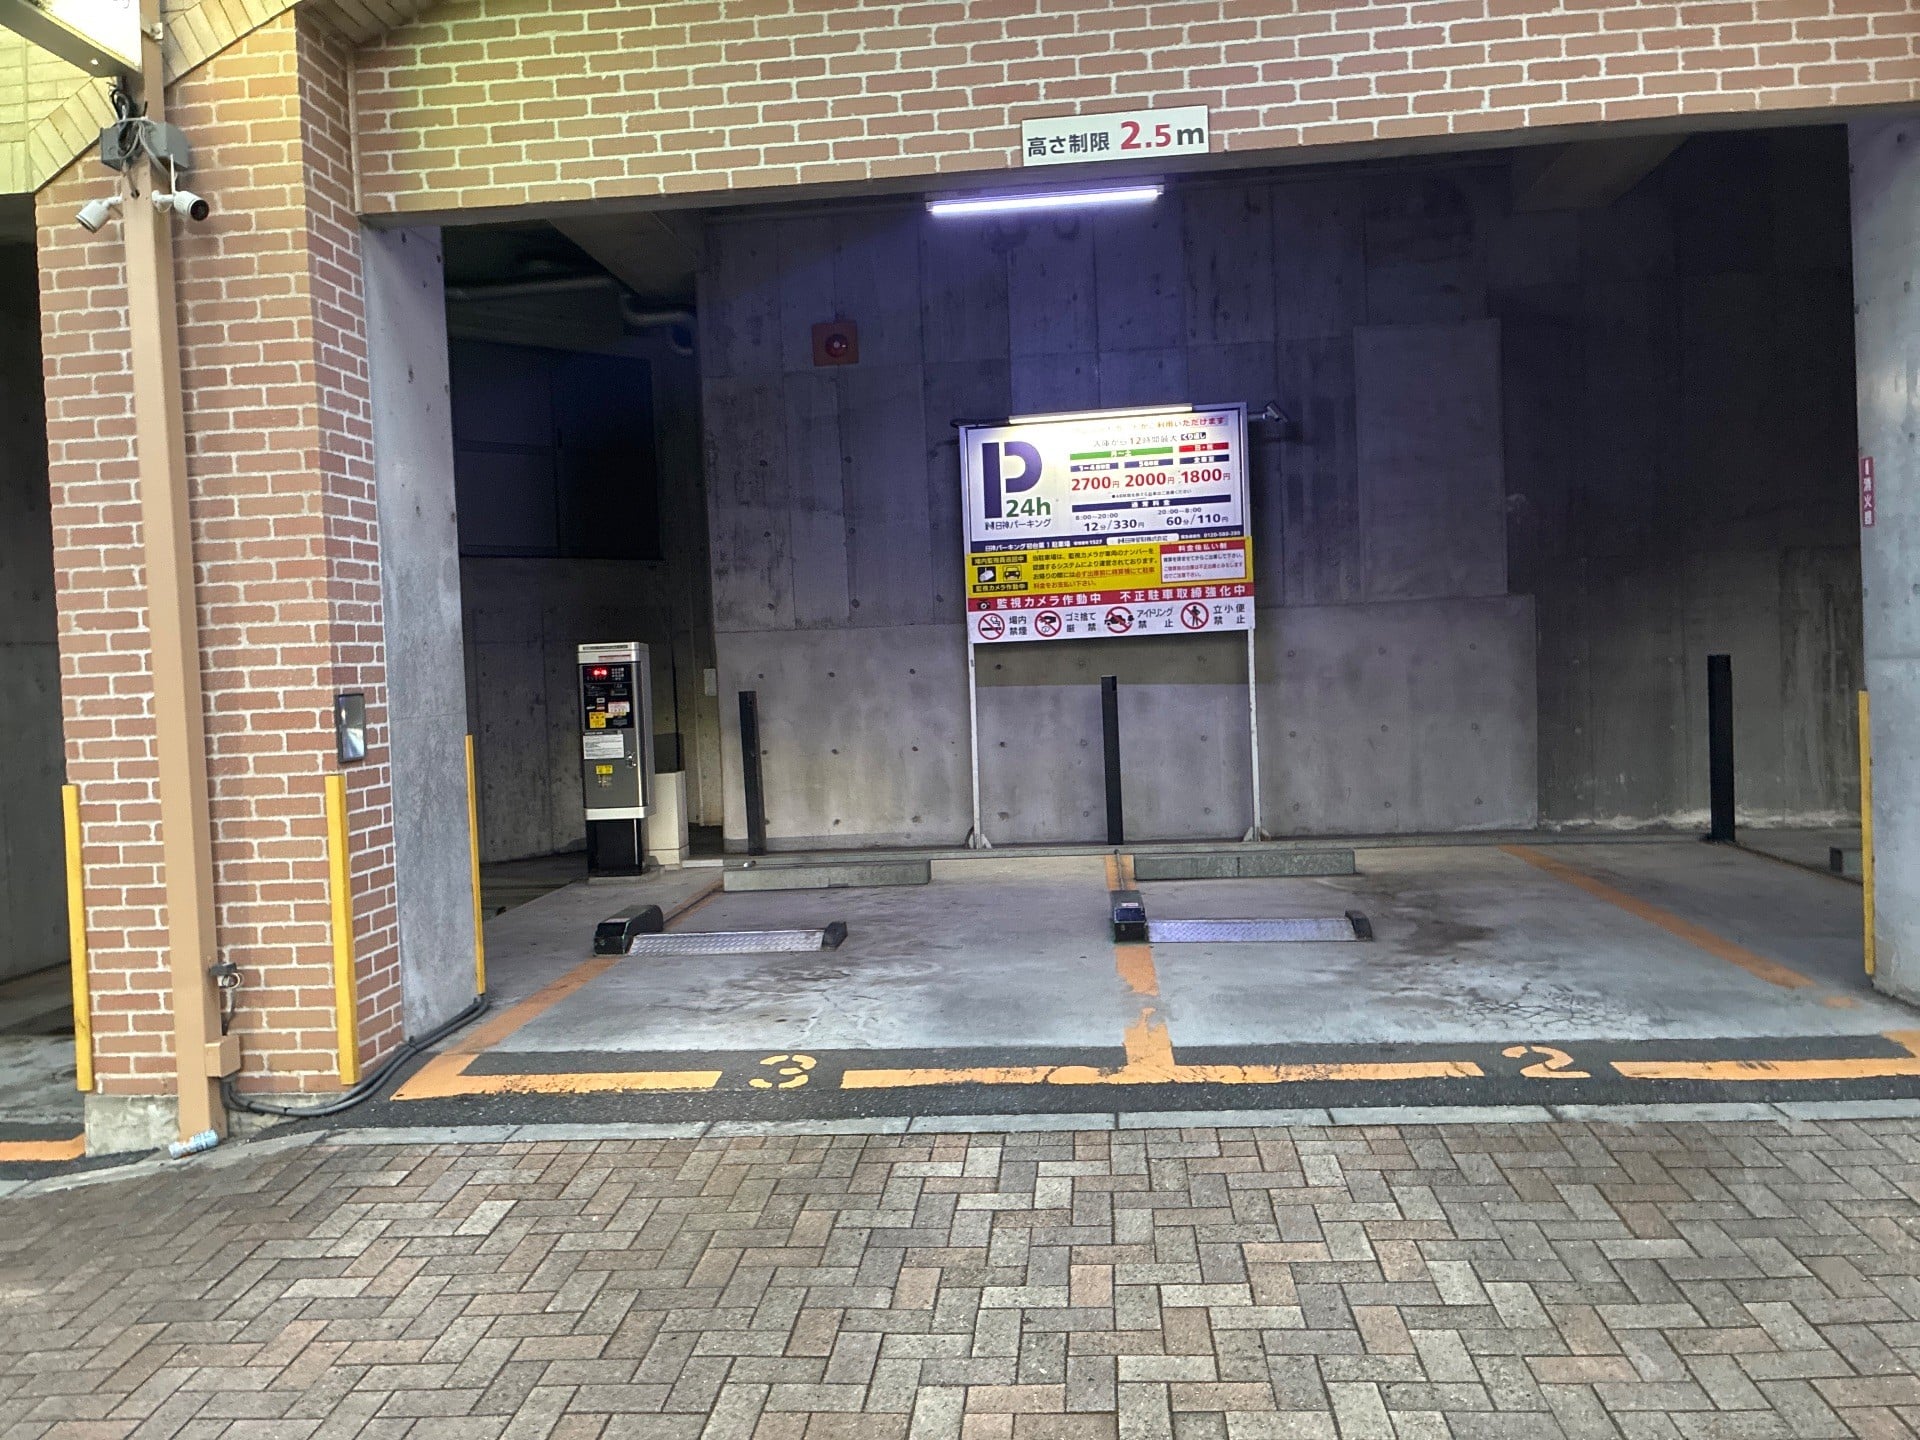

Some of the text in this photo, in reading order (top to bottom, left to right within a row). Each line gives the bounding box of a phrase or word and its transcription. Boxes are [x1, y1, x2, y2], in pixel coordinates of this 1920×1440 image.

[1027, 121, 1205, 157] 高さ制限 2.5m
[982, 441, 1043, 519] P
[1006, 497, 1051, 518] 24h
[996, 585, 1246, 609] 監視カメラ作動中 不正駐車取締強化中
[1065, 611, 1097, 622] ゴミ捨て
[1137, 607, 1175, 618] アイドリング
[1213, 603, 1246, 615] 立小便
[1009, 615, 1027, 625] 場内
[1009, 626, 1028, 636] 禁煙
[748, 1054, 818, 1089] 3
[1501, 1045, 1592, 1078] 2
